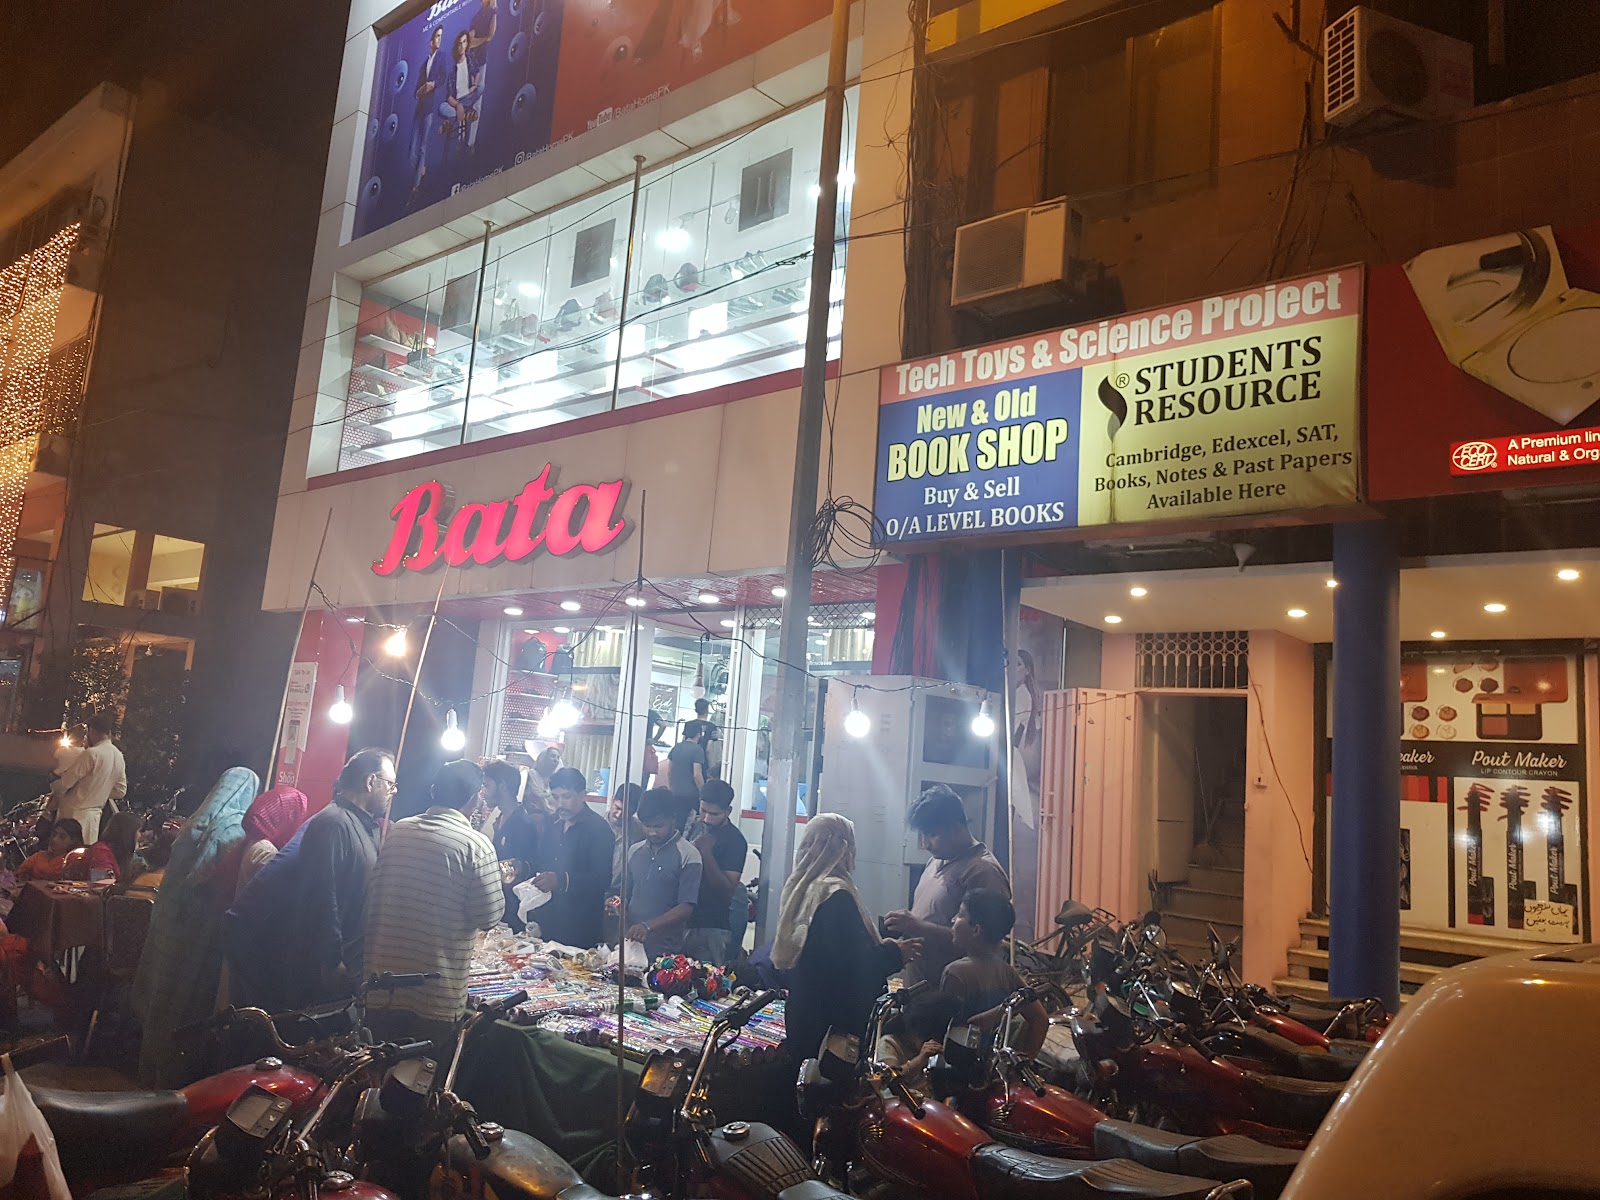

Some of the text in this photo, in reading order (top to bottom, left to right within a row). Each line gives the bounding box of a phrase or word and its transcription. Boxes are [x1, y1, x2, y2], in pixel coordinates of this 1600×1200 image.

[896, 272, 1342, 395] Tech Toys & Science Project
[1134, 335, 1322, 395] STUDENTS
[916, 385, 1038, 435] New & Old
[1133, 371, 1322, 426] RESOURCE
[887, 417, 1069, 482] BOOK SHOP
[1105, 423, 1339, 469] Cambridge, Edexcel, SAT,
[1460, 443, 1488, 457] ECO
[1507, 438, 1519, 451] A
[1521, 434, 1582, 449] Premium
[1507, 447, 1600, 466] Natural & Org
[1094, 451, 1353, 492] Books, Notes & Past Papers
[1460, 453, 1493, 468] CERT
[924, 475, 1021, 508] Buy & Sell
[1147, 480, 1287, 510] Available Here
[371, 461, 627, 576] Bata
[886, 501, 1065, 540] O/A LEVEL BOOKS
[1471, 750, 1568, 769] Pout Maker
[1493, 768, 1528, 776] CONTOUR
[1528, 769, 1559, 777] CRAYON
[1508, 869, 1517, 891] Pout
[1549, 873, 1559, 895] Pout
